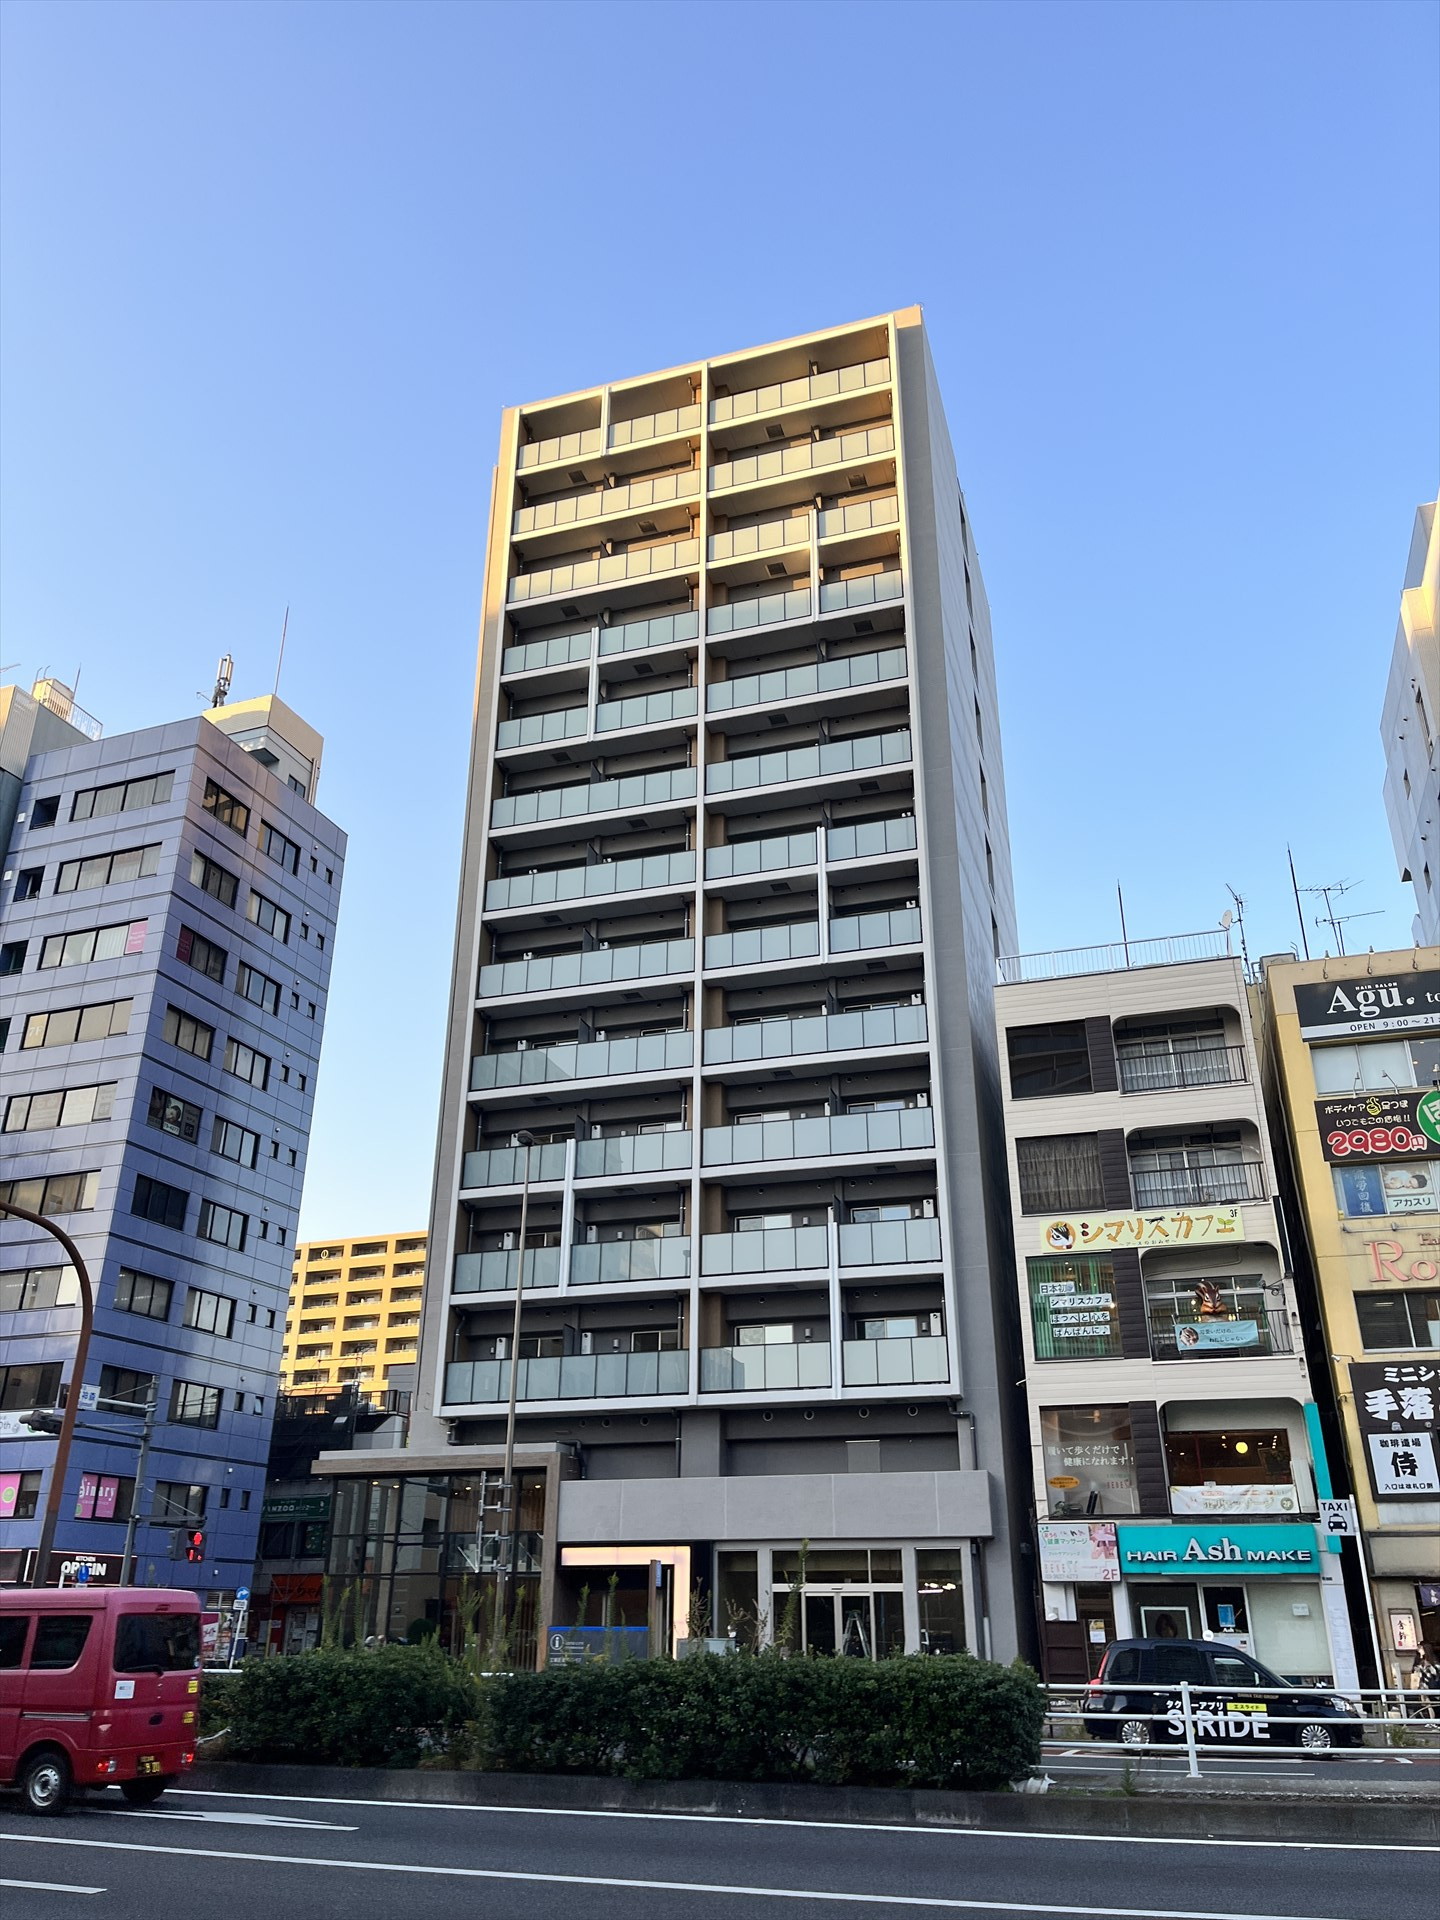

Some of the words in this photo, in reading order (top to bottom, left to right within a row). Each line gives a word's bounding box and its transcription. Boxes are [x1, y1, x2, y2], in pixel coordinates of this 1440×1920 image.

[1350, 1022, 1376, 1032] OPEN
[1393, 1197, 1431, 1208] アカスリ
[1229, 1209, 1239, 1218] 3F
[1363, 1240, 1440, 1283] Ro
[1051, 1297, 1111, 1307] シマリスカフェ
[1383, 1365, 1440, 1382] ミニシ
[1364, 1387, 1440, 1420] 手落
[1391, 1451, 1418, 1477] 侍
[1321, 1502, 1348, 1511] TAXI
[1126, 1550, 1178, 1562] HAIR
[1182, 1537, 1243, 1562] Ash
[1246, 1550, 1312, 1562] MAKE
[1102, 1569, 1118, 1580] 2F
[1166, 1700, 1224, 1710] タクーアプリ
